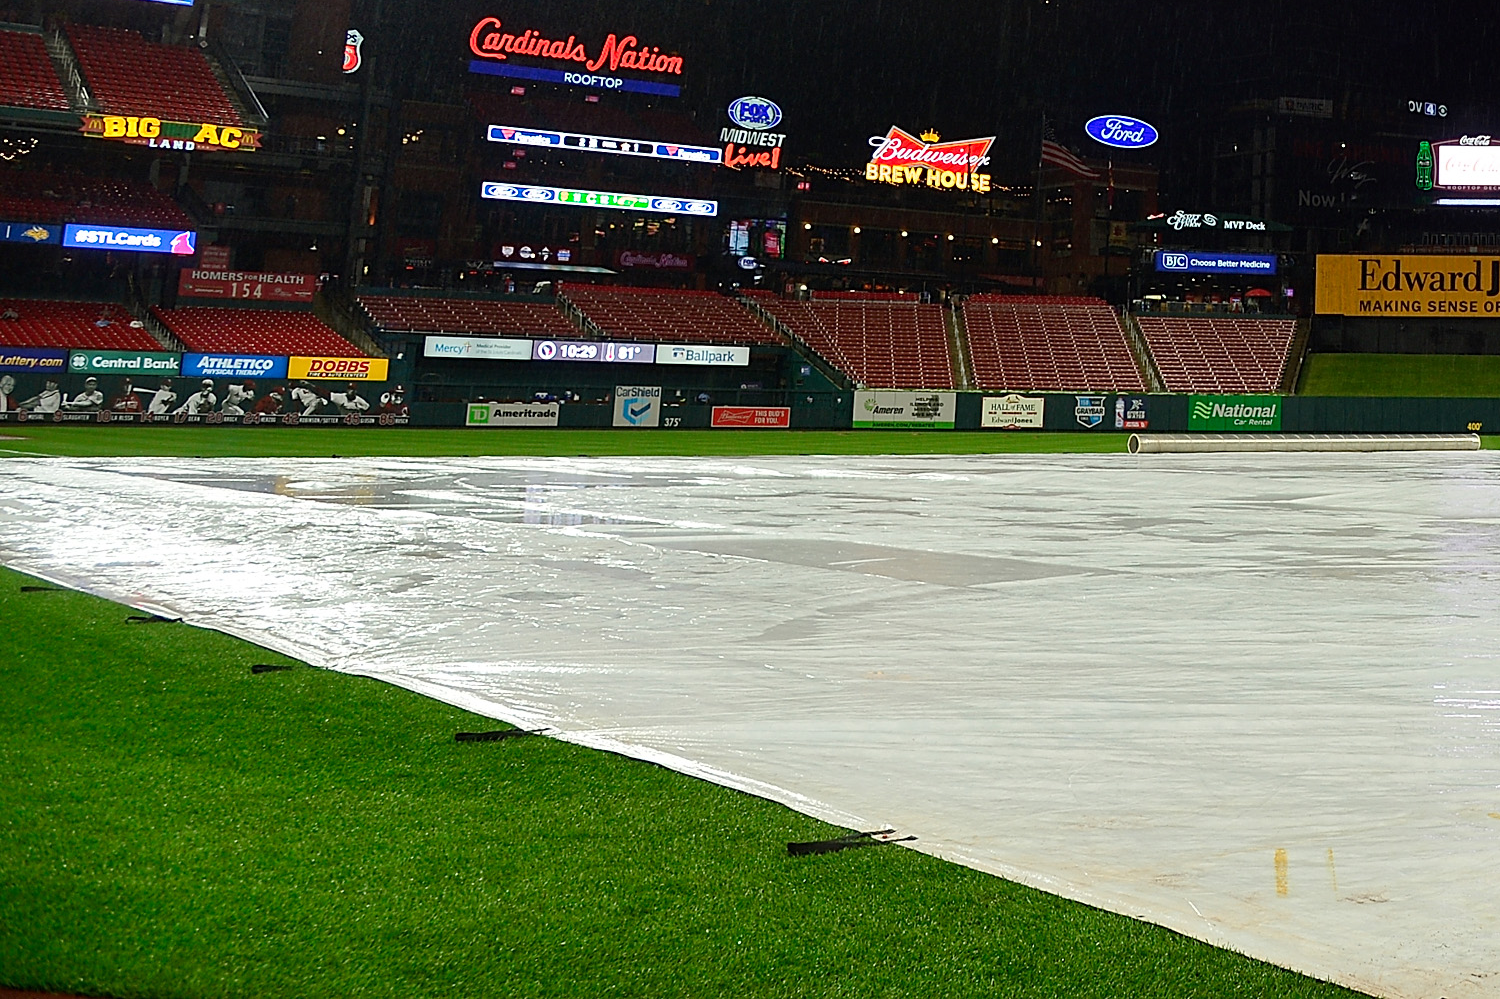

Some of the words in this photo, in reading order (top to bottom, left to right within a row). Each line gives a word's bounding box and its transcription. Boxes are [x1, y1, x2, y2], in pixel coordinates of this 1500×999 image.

[469, 16, 587, 62] Cardinals
[586, 33, 684, 75] Nation
[564, 71, 623, 89] ROOFTOP
[740, 101, 770, 119] FOX
[1427, 103, 1435, 115] 4
[102, 116, 161, 139] BIG
[1101, 118, 1145, 142] Ford
[147, 138, 196, 151] LAND
[719, 127, 787, 148] MIDWEST
[724, 142, 781, 169] Live!
[868, 136, 990, 166] Budweiser
[866, 162, 923, 185] BREW
[926, 168, 991, 192] HOUSE
[1298, 189, 1336, 208] Now
[1223, 220, 1244, 230] MVP
[1246, 221, 1266, 231] Deck
[74, 229, 162, 247] #STLCards
[1166, 256, 1186, 267] BJC
[1190, 258, 1216, 267] Choose
[1217, 259, 1238, 268] Better
[1240, 260, 1270, 269] Medicine
[192, 270, 243, 282] HOMERS
[258, 274, 304, 285] HEALTH
[1357, 259, 1484, 292] Edward
[231, 282, 263, 299] 154
[1359, 300, 1422, 313] MAKING
[1427, 301, 1478, 313] SENSE
[435, 344, 464, 355] Mercy
[685, 349, 734, 363] Ballpark
[92, 356, 140, 370] Central
[143, 356, 179, 370] Bank
[196, 355, 274, 371] ATHLETICO
[309, 359, 370, 373] DOBBS
[202, 368, 234, 376] PHYSICAL
[235, 369, 265, 377] THERAPY
[616, 387, 660, 398] CarShield
[18, 409, 28, 423] 6
[53, 410, 62, 423] 9
[471, 408, 488, 421] TD
[493, 409, 557, 419] Ameritrade
[755, 410, 767, 418] THIS
[872, 405, 904, 415] Ameren
[1076, 407, 1104, 415] GRAYBAR
[1212, 403, 1275, 418] National
[282, 413, 299, 425] 42
[1233, 418, 1245, 426] Car
[1247, 418, 1272, 426] Rental
